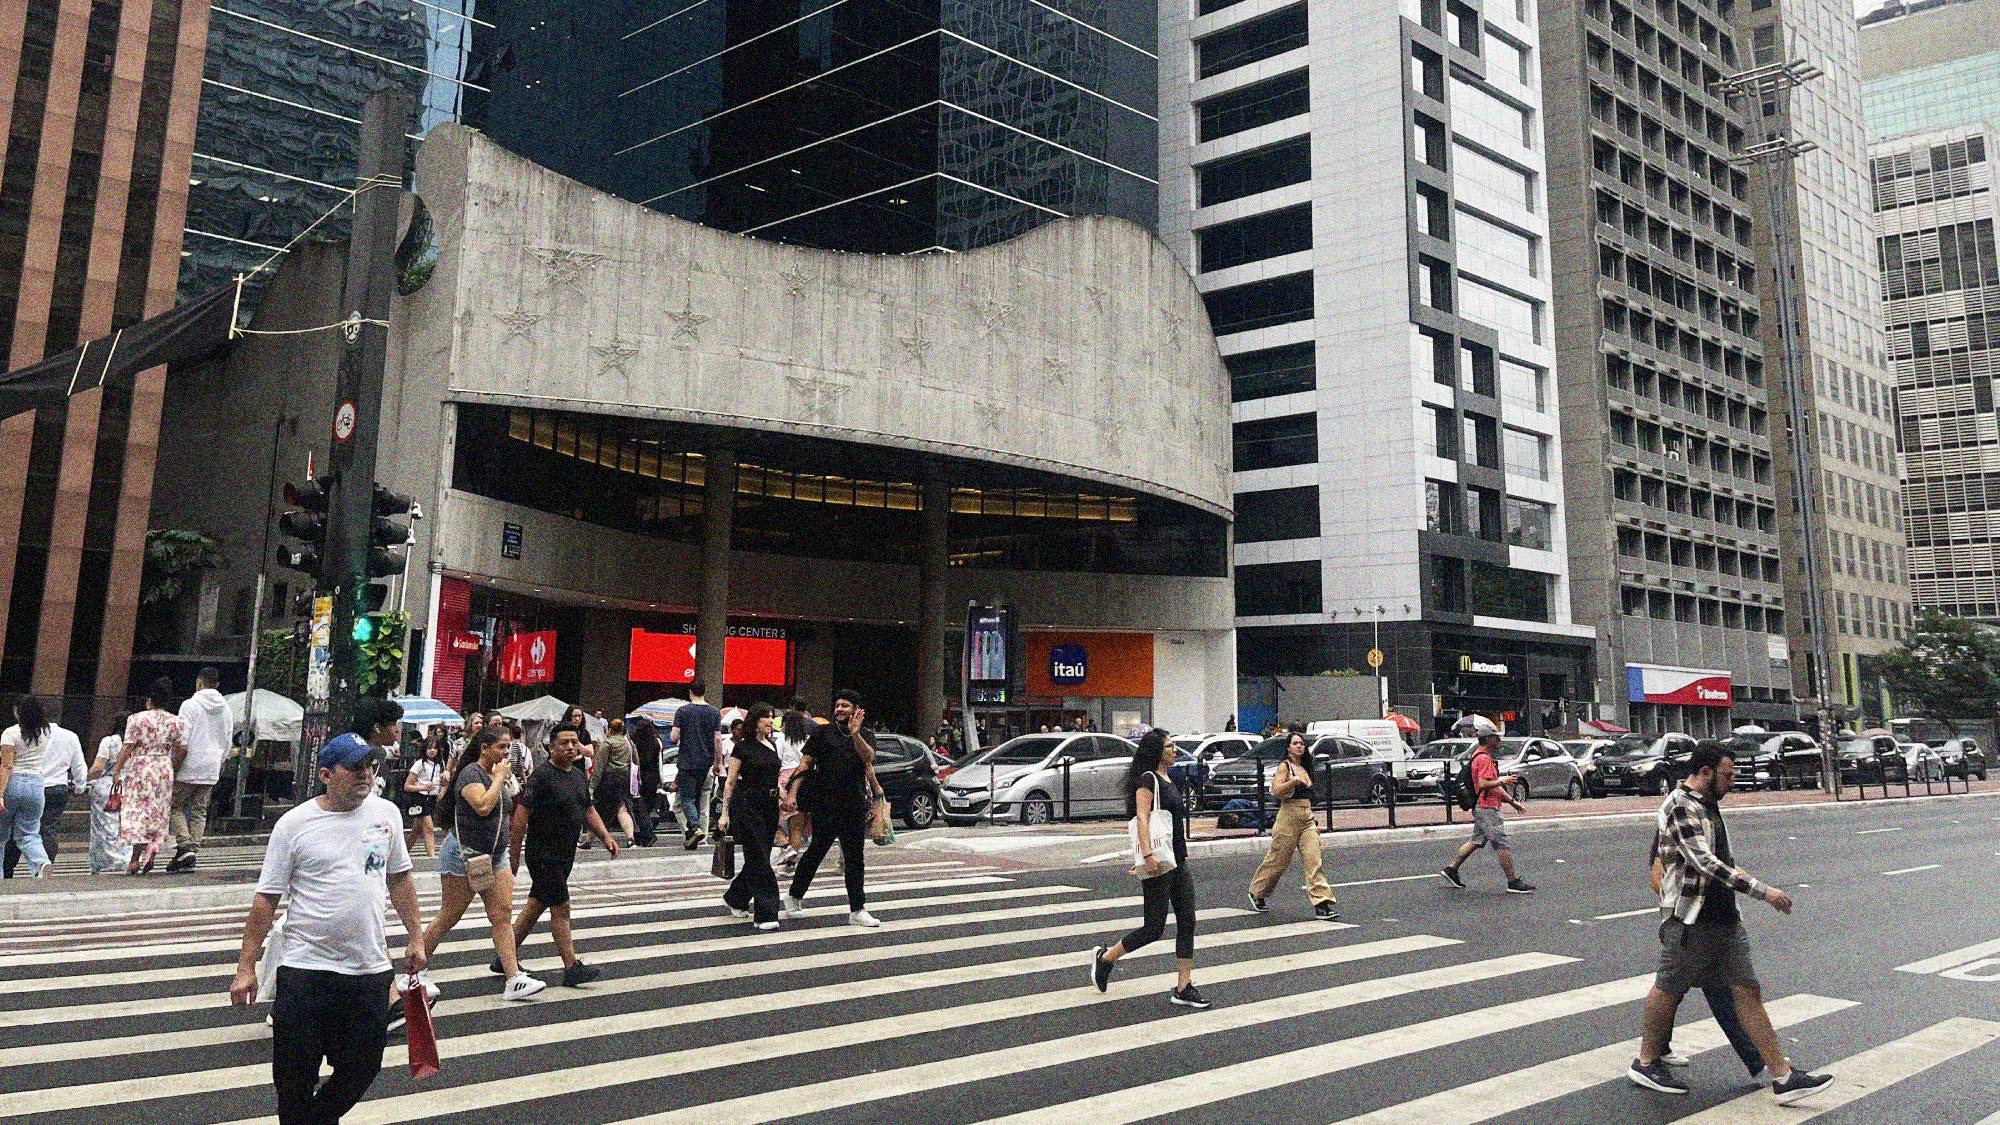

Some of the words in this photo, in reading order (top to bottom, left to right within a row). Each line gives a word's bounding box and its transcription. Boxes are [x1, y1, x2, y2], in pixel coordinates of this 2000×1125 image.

[738, 626, 778, 638] CENTER
[780, 628, 785, 638] 3
[1054, 661, 1084, 677] itaú
